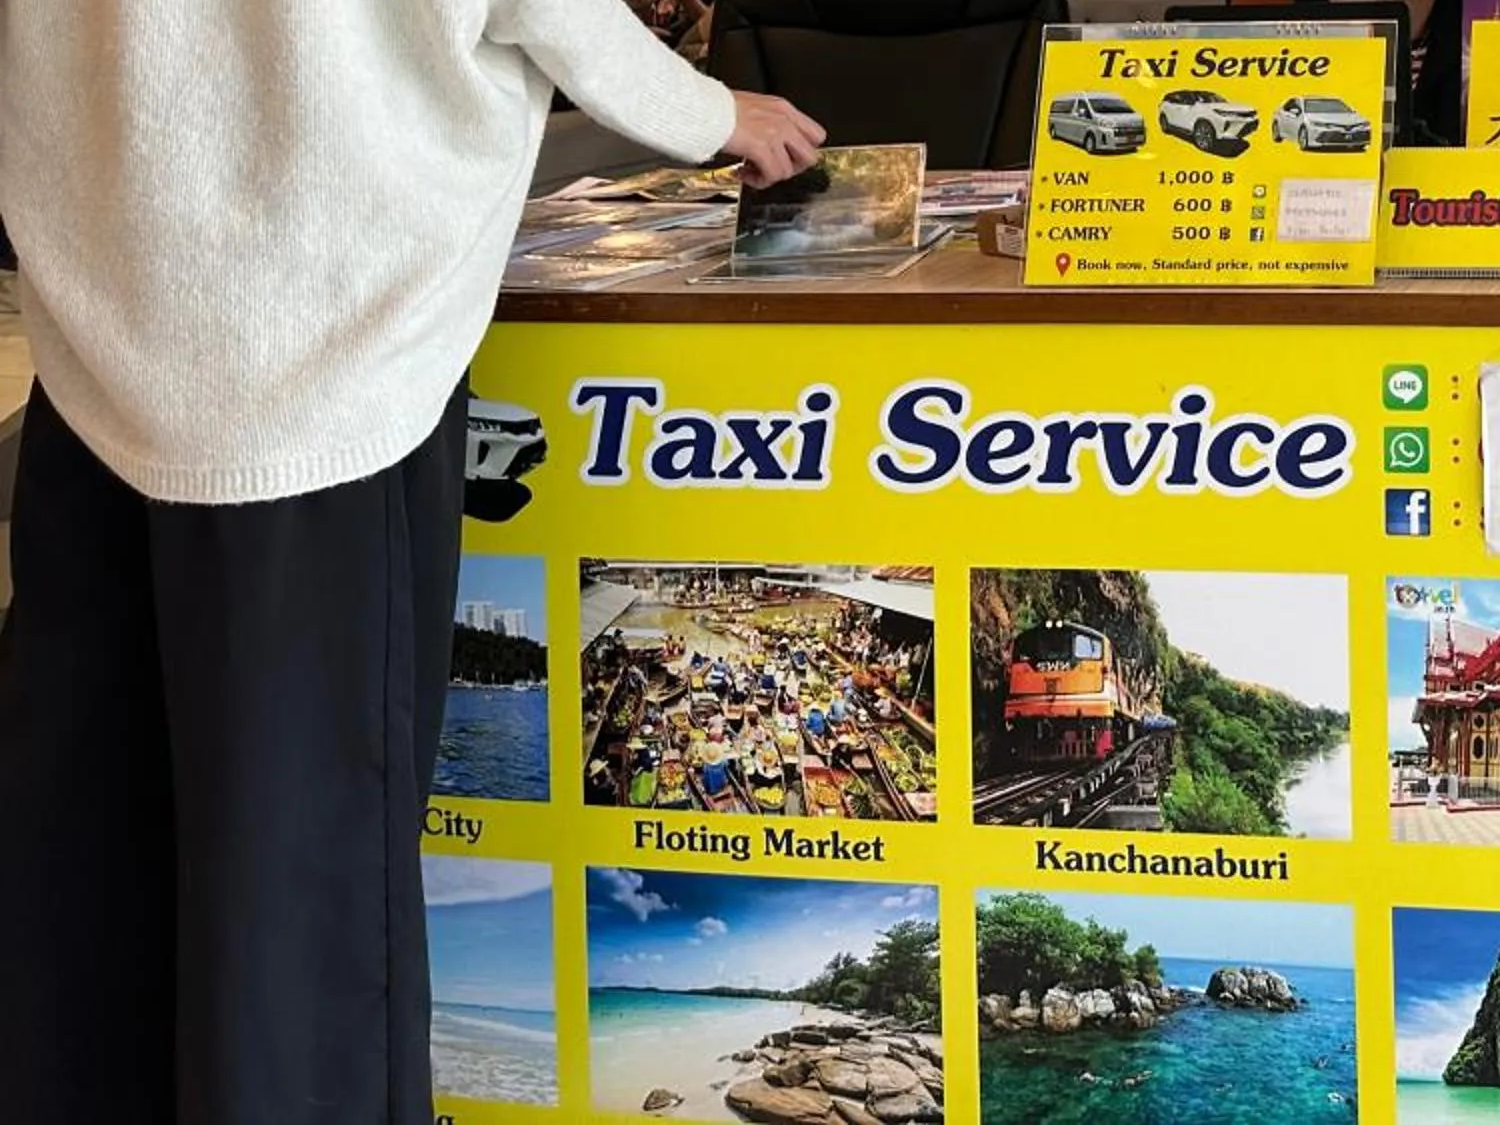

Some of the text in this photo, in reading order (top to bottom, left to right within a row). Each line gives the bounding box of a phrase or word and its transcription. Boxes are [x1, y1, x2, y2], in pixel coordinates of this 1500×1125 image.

[1100, 47, 1331, 78] Taxi Service
[1053, 171, 1090, 186] VAN
[1158, 170, 1213, 187] 1,000
[1050, 197, 1145, 213] FORTUNER
[1173, 197, 1212, 213] 600
[1048, 226, 1112, 242] CAMRY
[1171, 226, 1211, 241] 500
[1077, 258, 1111, 271] Book
[1152, 257, 1211, 271] Standard
[1258, 260, 1281, 271] not
[1285, 259, 1349, 273] expensive
[576, 385, 1348, 489] Taxi Service
[423, 806, 483, 844] City
[635, 820, 885, 863] Floting Market
[1035, 841, 1290, 881] Kanchanaburi
